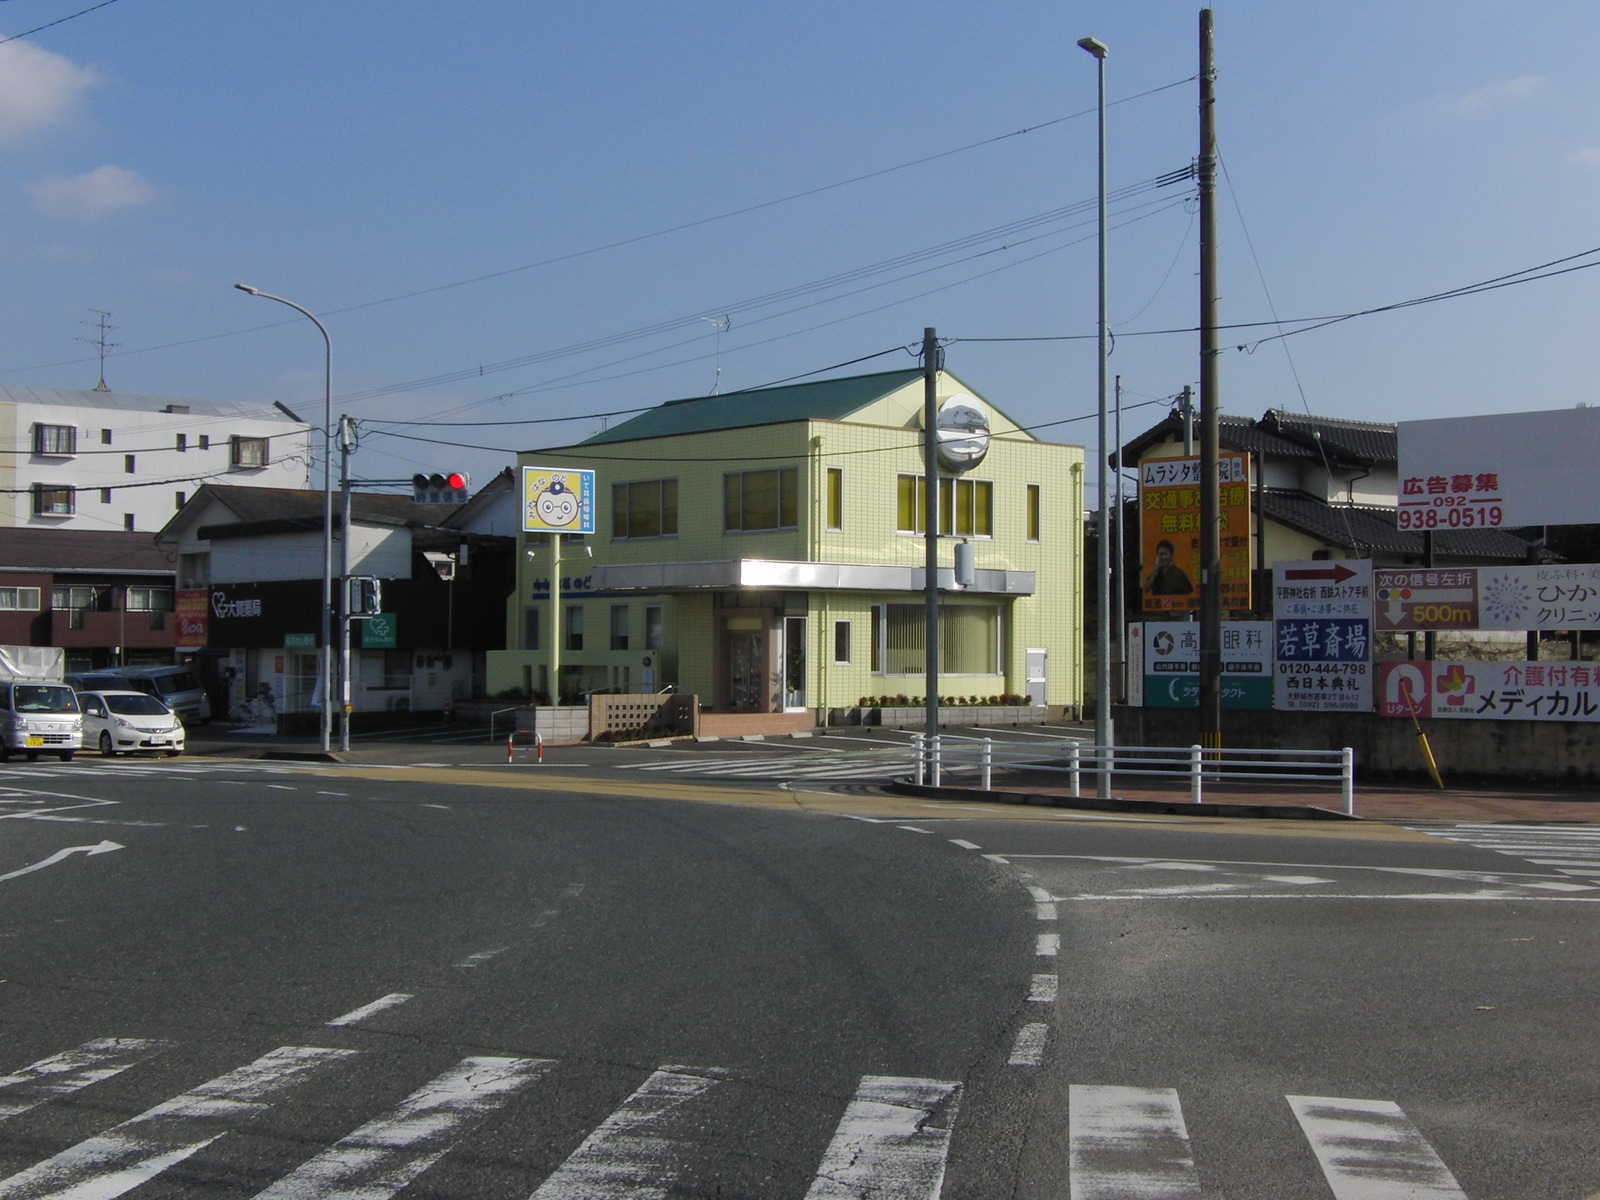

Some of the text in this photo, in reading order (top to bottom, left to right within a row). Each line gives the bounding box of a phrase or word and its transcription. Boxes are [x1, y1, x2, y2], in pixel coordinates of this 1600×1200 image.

[1145, 462, 1229, 483] ムラシタ整院
[1403, 473, 1498, 495] 広告募集
[1433, 496, 1466, 507] 092
[1399, 506, 1502, 529] 938-0519
[1379, 573, 1471, 586] 次の信号左折
[1276, 586, 1368, 599] 平野神社右折 西鉄ストア手前
[1536, 584, 1597, 602] ひか
[1413, 606, 1471, 622] 500m
[1181, 631, 1262, 649] 高眼科
[1280, 664, 1366, 675] 0120-444-798
[1286, 676, 1360, 690] 西日本典礼
[1476, 689, 1598, 716] メディカル
